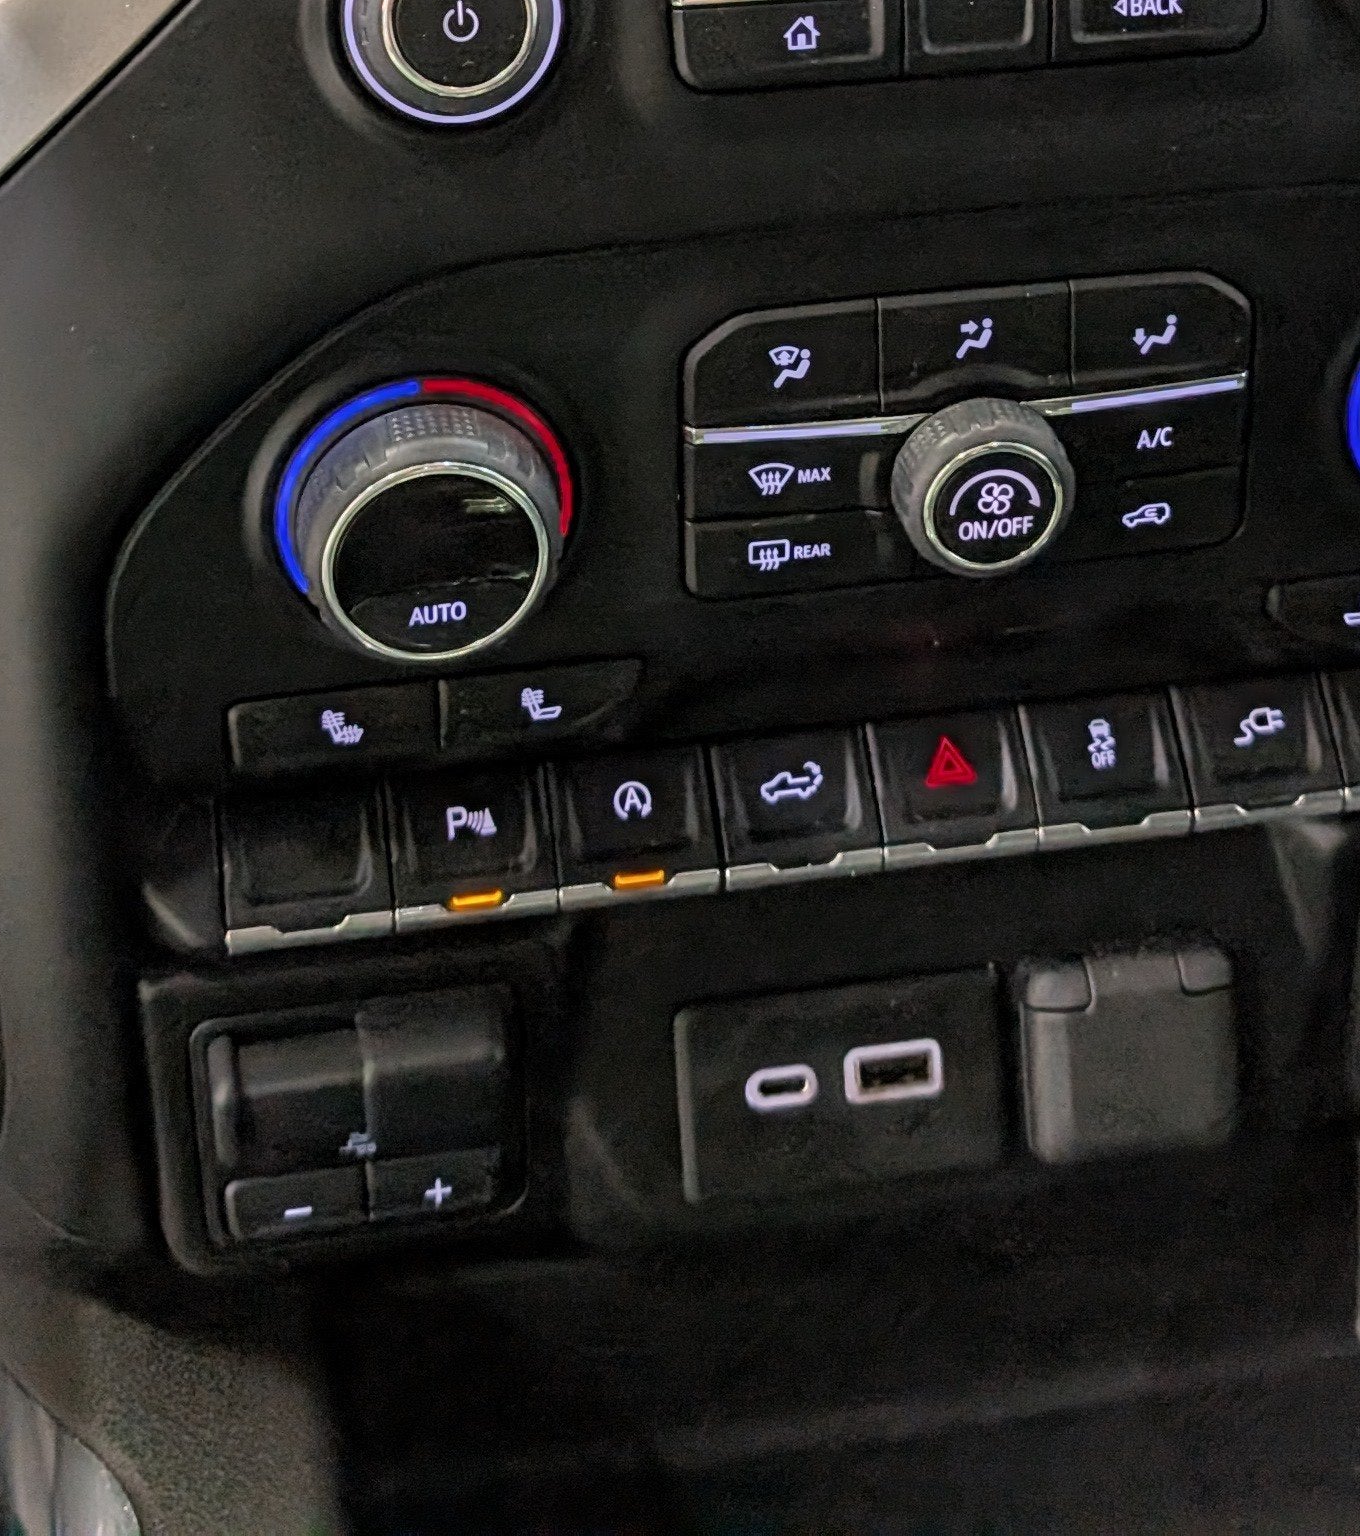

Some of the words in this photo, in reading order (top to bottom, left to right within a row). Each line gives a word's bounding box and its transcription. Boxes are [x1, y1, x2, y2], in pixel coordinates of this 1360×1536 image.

[1136, 426, 1173, 450] A/C
[797, 466, 831, 484] MAX
[957, 515, 1034, 542] ON/OFF
[793, 542, 831, 560] REAR
[408, 600, 467, 627] AUTO
[1091, 750, 1116, 769] OFF
